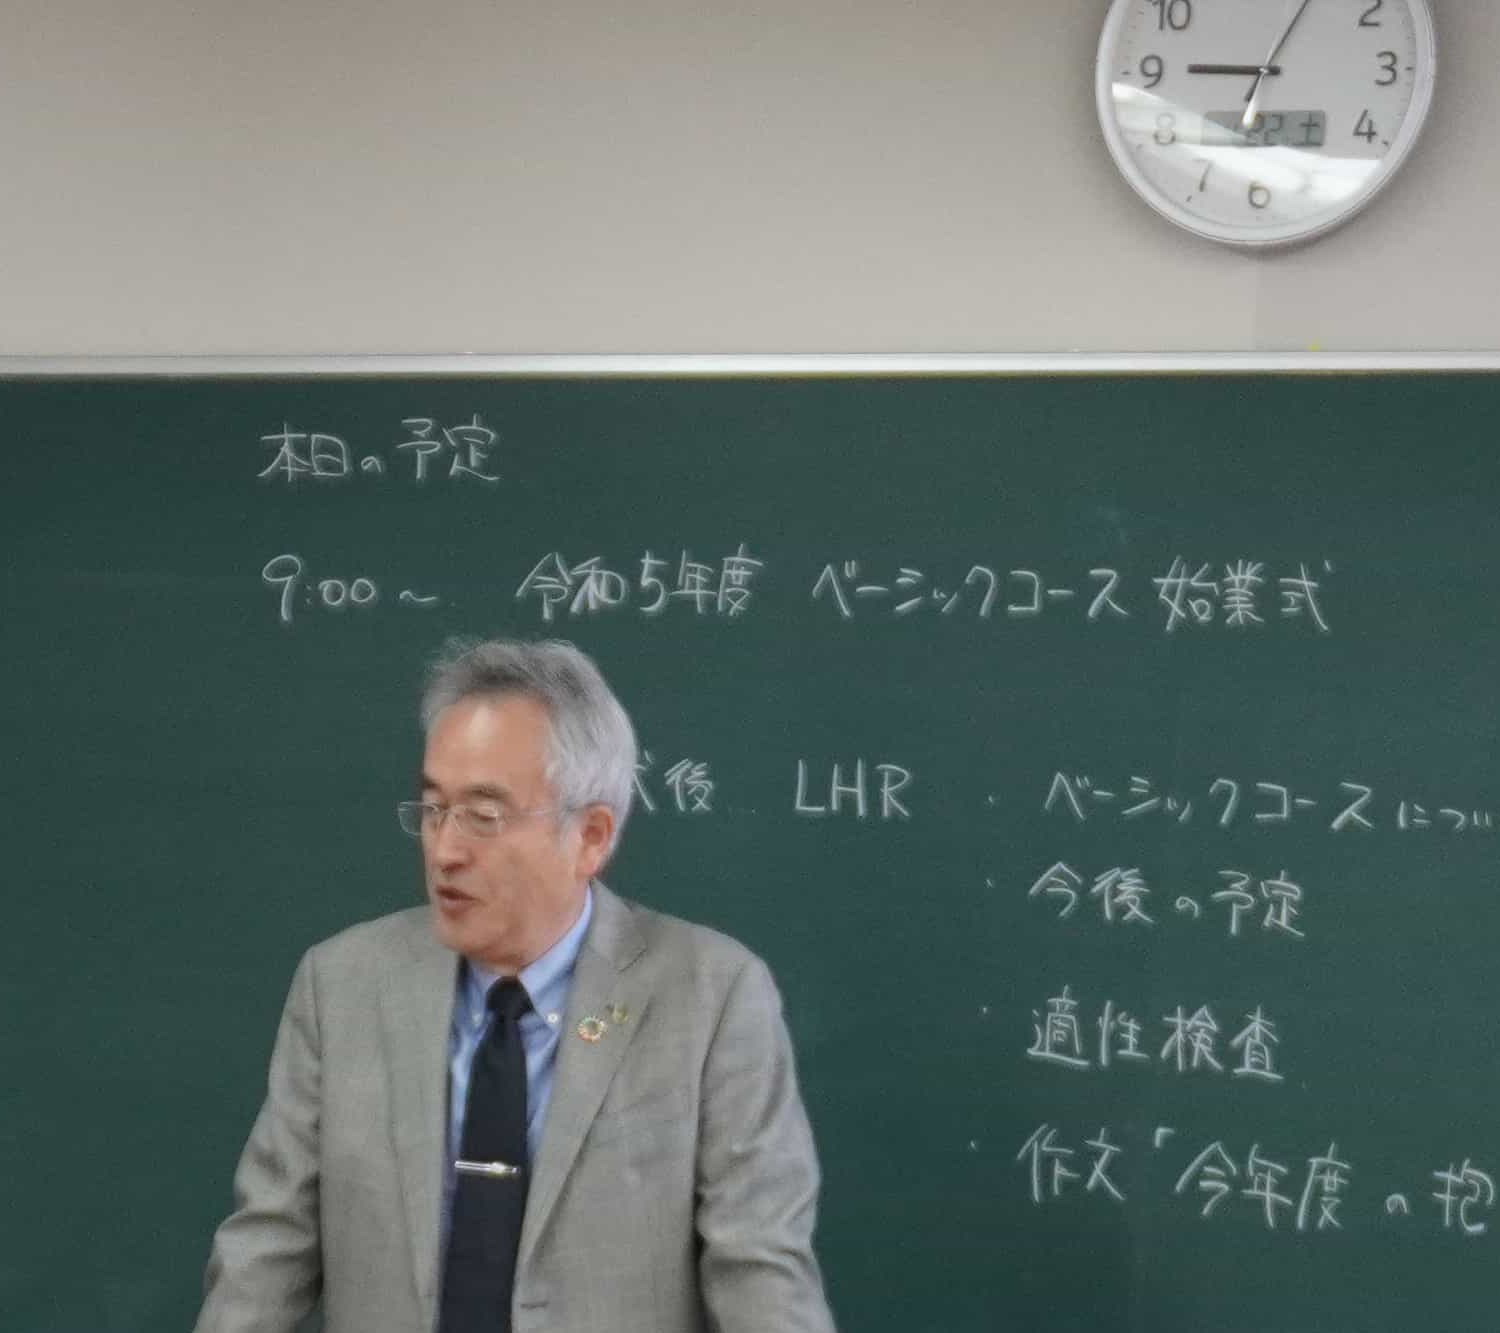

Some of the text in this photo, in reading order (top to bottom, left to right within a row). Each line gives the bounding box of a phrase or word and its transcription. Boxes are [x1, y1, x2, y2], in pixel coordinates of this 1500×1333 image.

[1154, 0, 1191, 31] 10
[1358, 0, 1381, 27] 2
[1139, 54, 1164, 88] 9
[1374, 51, 1397, 86] 3
[1353, 109, 1378, 144] 4
[257, 414, 500, 482] 本日の予定
[796, 757, 911, 818] LHR
[1028, 861, 1304, 936] 今後の予定
[1027, 985, 1283, 1080] 適性検査
